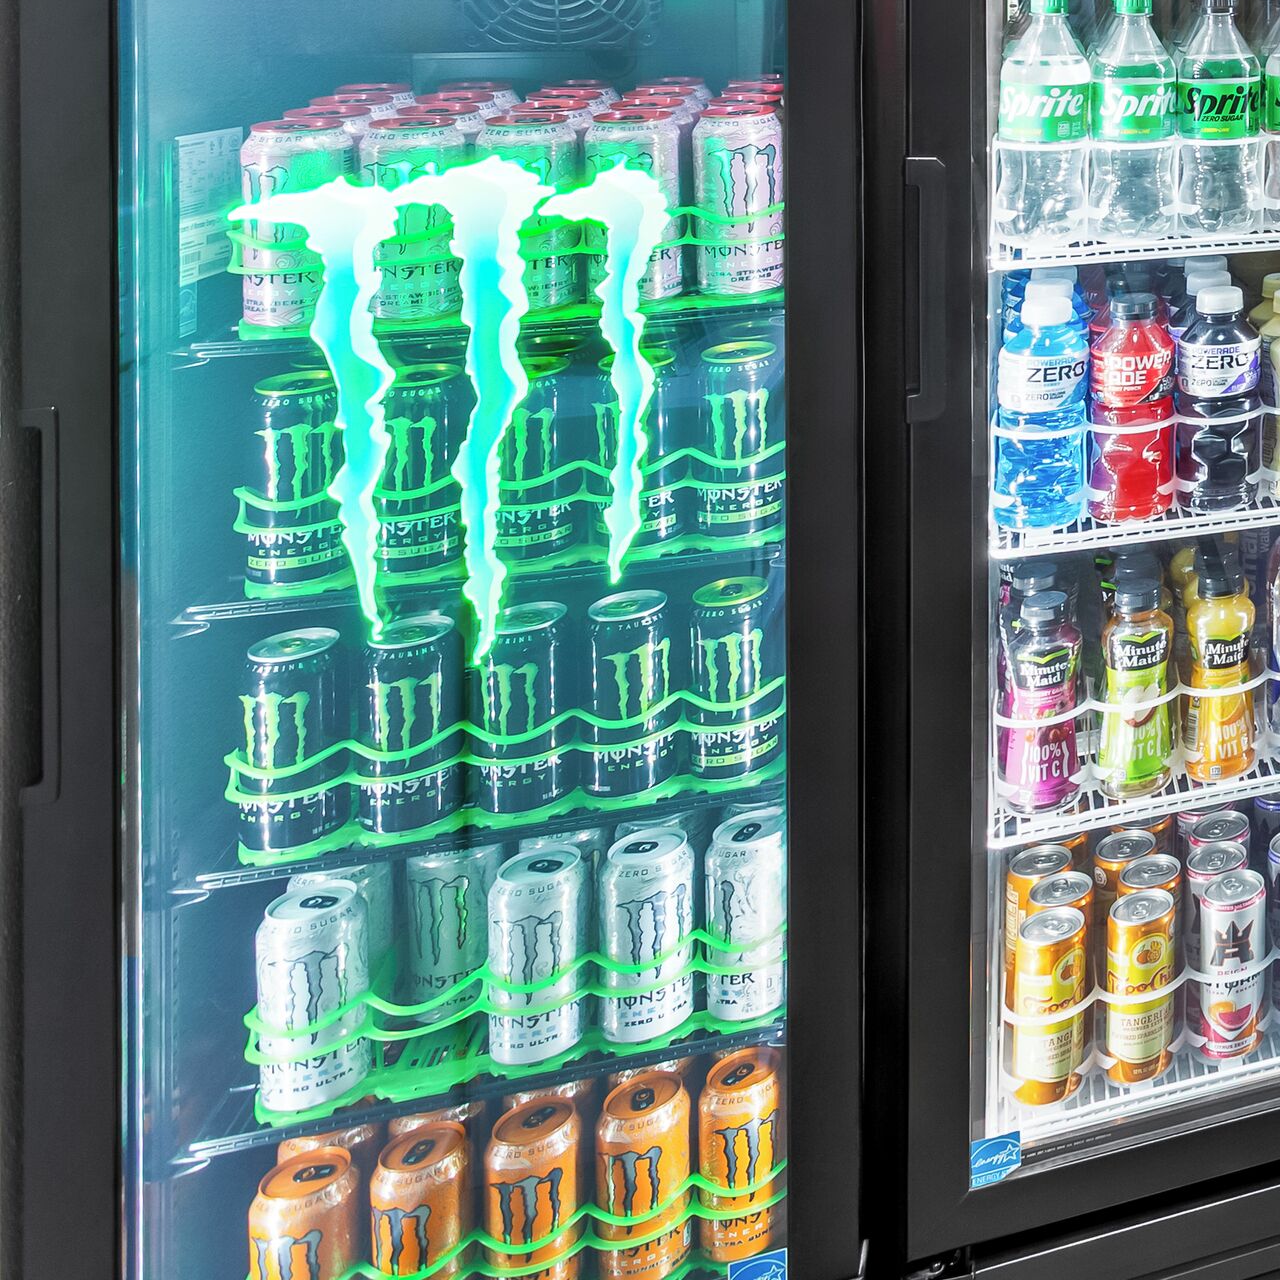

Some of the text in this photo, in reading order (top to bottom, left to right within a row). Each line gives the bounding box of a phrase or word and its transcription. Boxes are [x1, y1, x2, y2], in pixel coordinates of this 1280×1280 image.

[1202, 114, 1219, 122] ZERO
[1027, 360, 1085, 383] ZERO
[382, 646, 435, 659] TAURINE
[1118, 639, 1167, 660] Minute
[619, 869, 648, 878] ZERO
[310, 907, 353, 932] SUGAR
[624, 1017, 653, 1028] ZERO
[715, 1097, 744, 1105] ZERO
